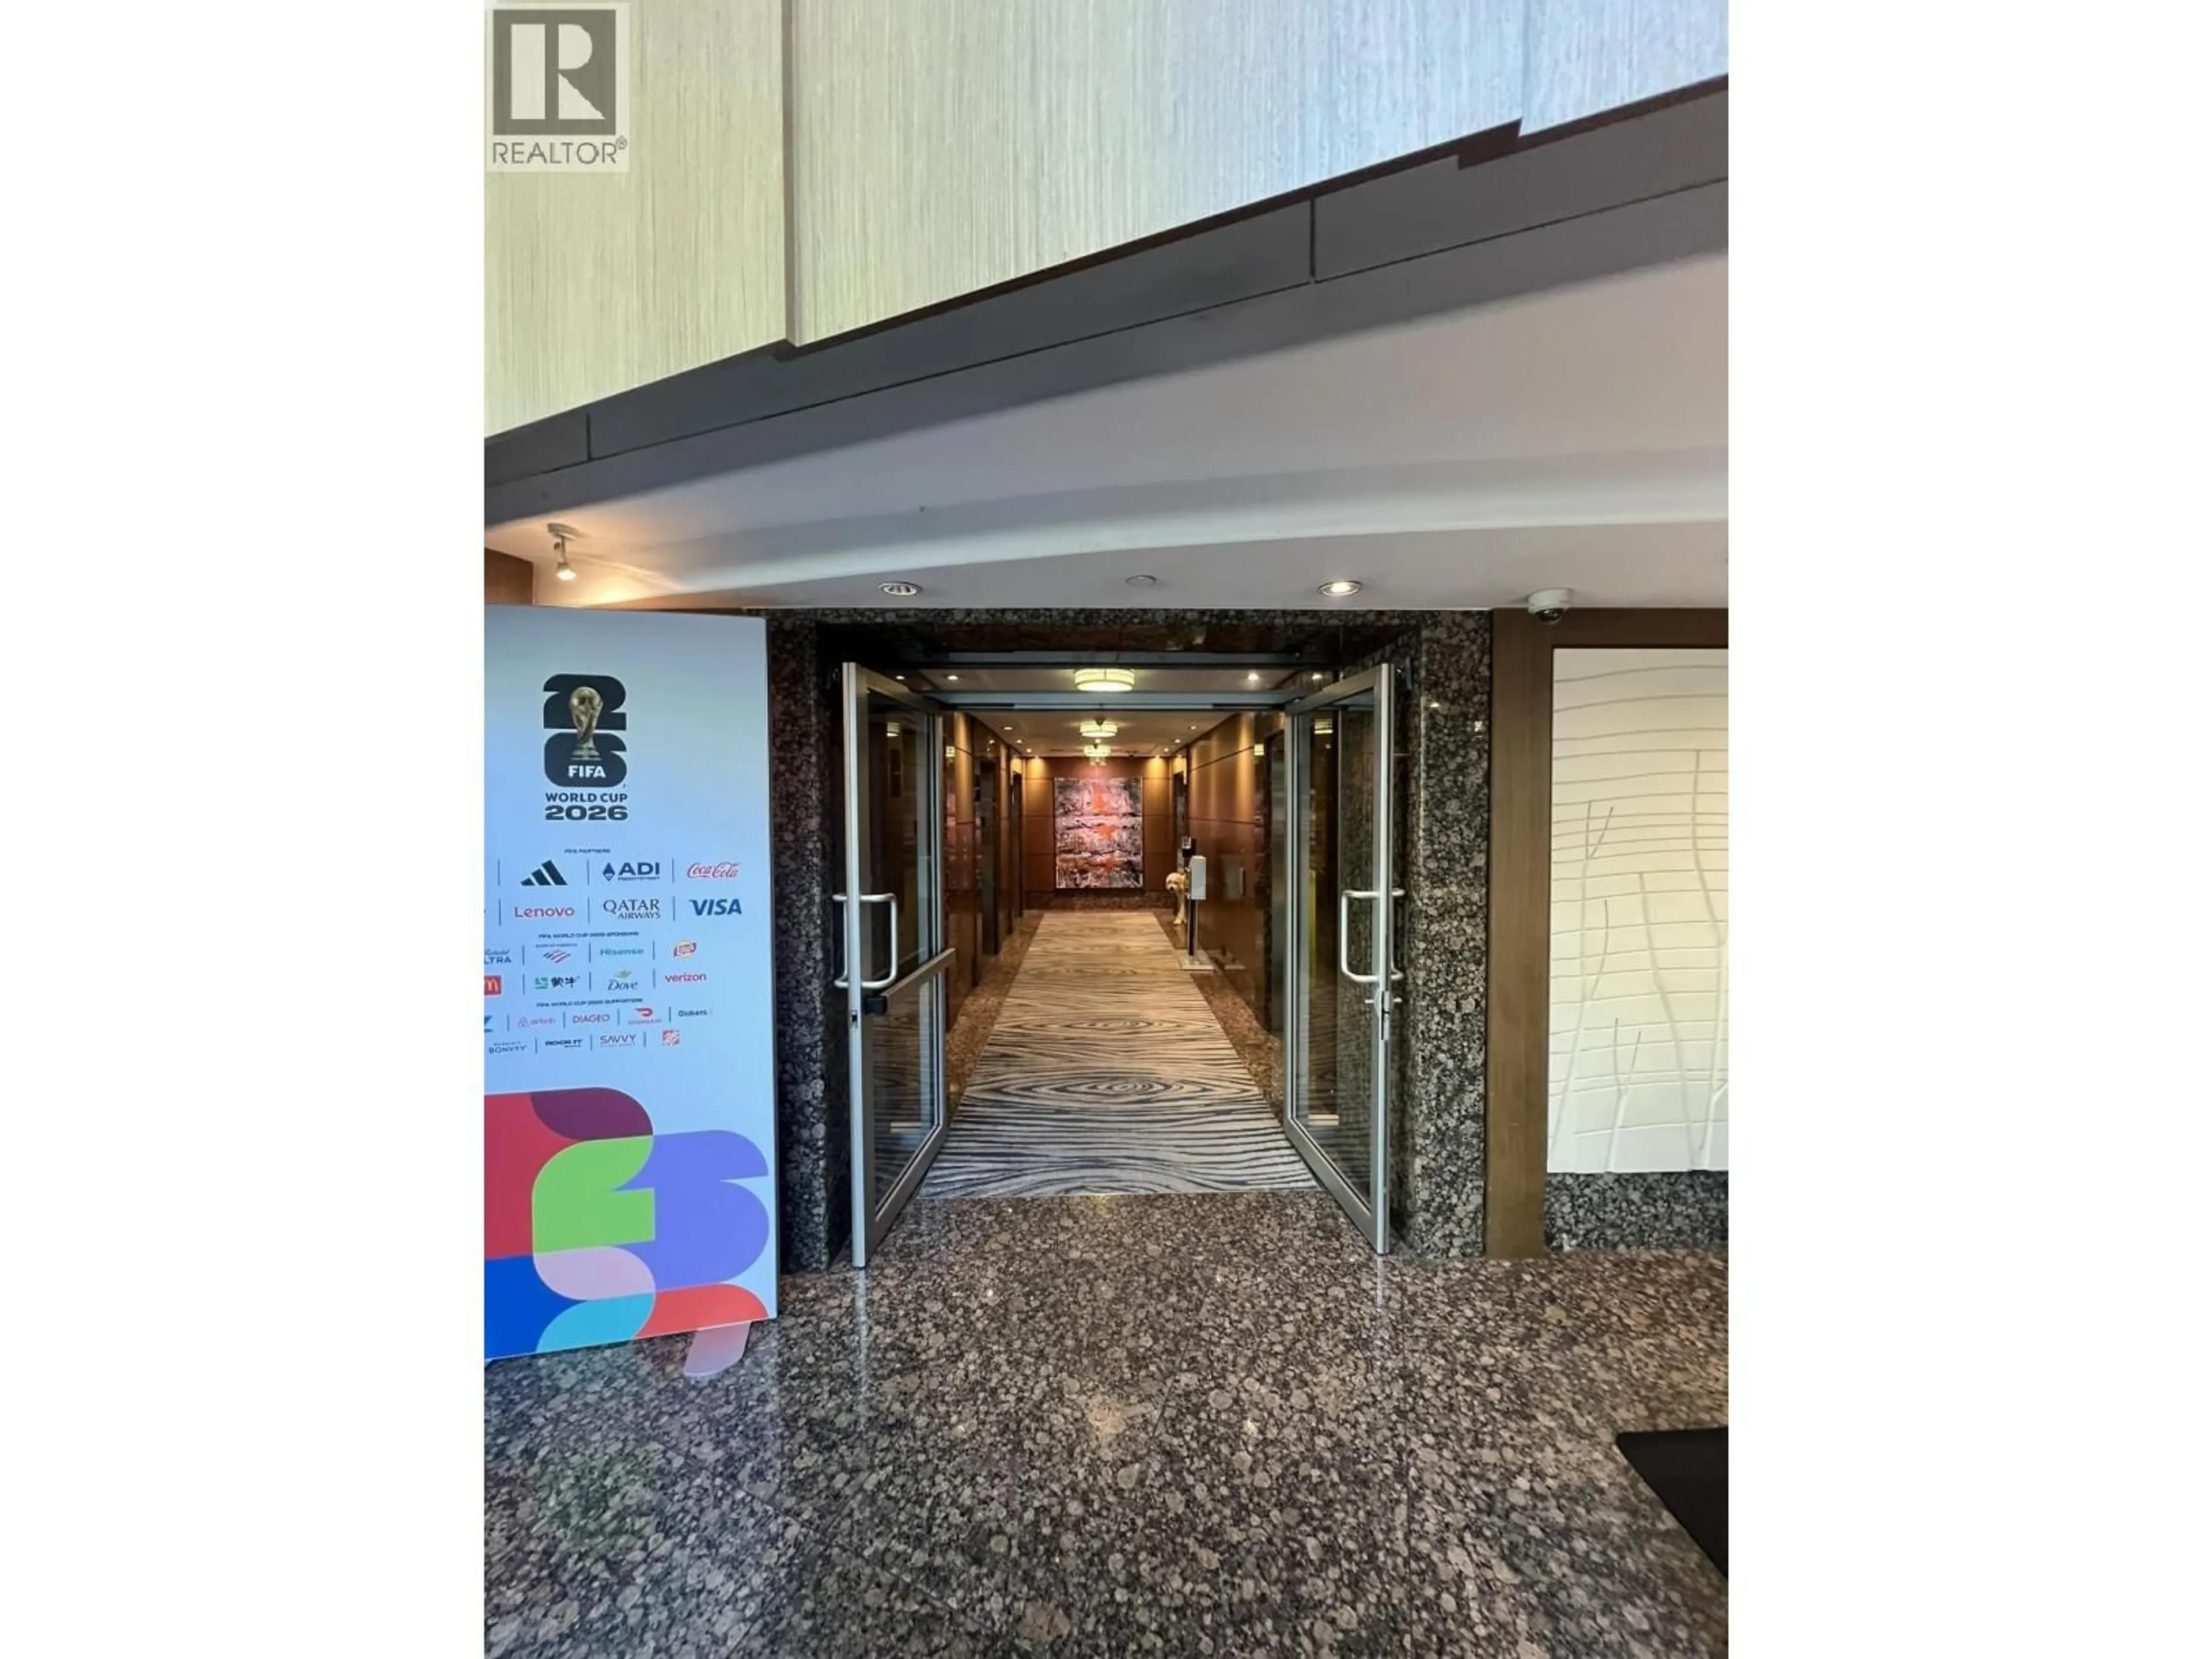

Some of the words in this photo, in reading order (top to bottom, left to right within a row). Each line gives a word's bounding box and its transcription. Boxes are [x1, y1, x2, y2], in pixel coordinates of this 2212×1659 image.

[568, 765, 606, 778] FIFA
[546, 793, 597, 802] WORLD
[600, 793, 628, 803] CUP
[545, 805, 628, 820] 2026
[618, 862, 660, 876] ADI
[603, 898, 660, 915] QATAR
[689, 898, 742, 916] VISA
[514, 907, 575, 918] Lenovo
[618, 911, 661, 919] AIRWAYS
[600, 948, 645, 956] Hisense
[665, 972, 707, 983] verizon
[608, 979, 638, 990] Dove
[573, 1014, 611, 1024] DIAGEO
[600, 1035, 636, 1044] SAVVY
